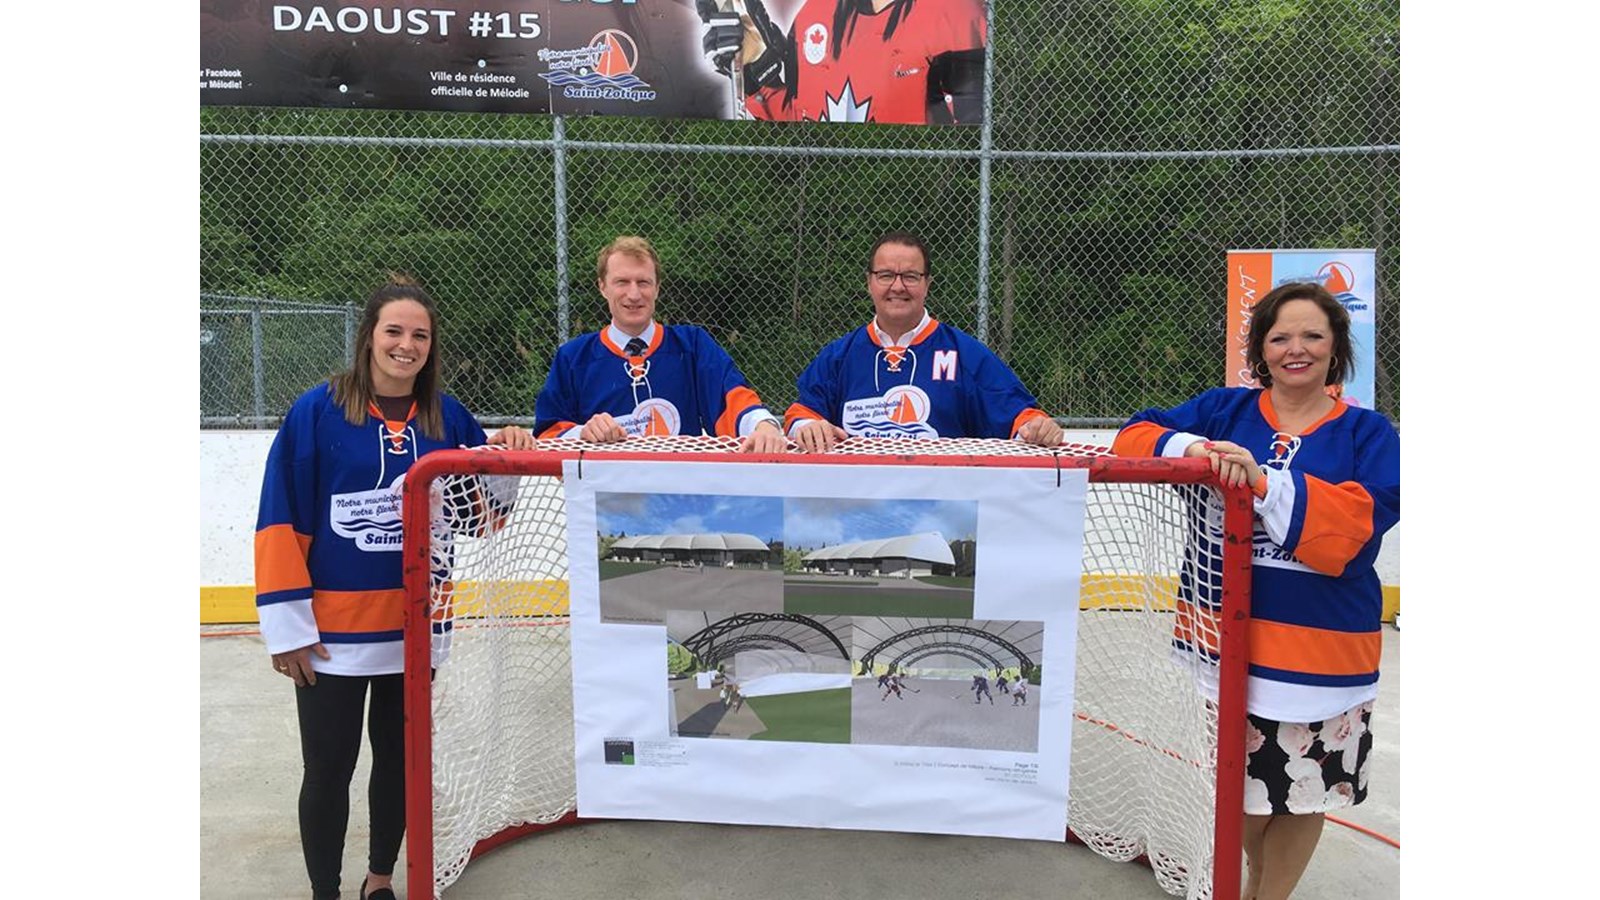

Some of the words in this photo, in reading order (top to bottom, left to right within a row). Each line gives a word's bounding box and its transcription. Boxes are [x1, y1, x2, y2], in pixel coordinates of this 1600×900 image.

[272, 5, 456, 36] DAOUST
[469, 12, 541, 39] #15
[206, 68, 242, 77] Facebook
[430, 71, 452, 81] Ville
[455, 72, 467, 82] de
[470, 72, 516, 83] résidence
[209, 80, 242, 89] Mélodie!
[431, 86, 473, 97] officielle
[475, 87, 488, 97] de
[490, 87, 529, 98] Mélodie
[564, 86, 656, 101] Saint-Zotique
[932, 350, 957, 381] M
[336, 499, 361, 508] Notre
[350, 507, 374, 517] notre
